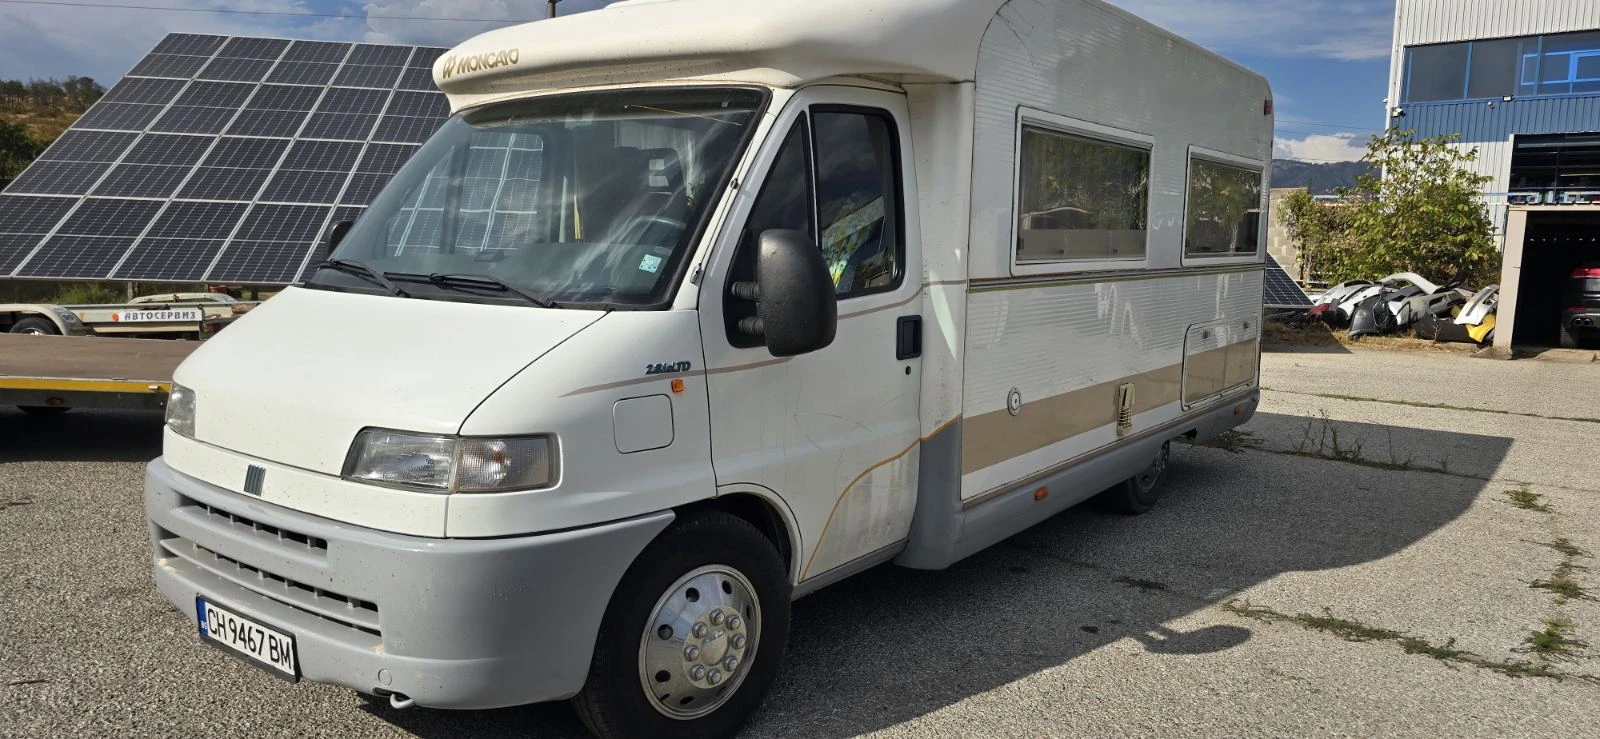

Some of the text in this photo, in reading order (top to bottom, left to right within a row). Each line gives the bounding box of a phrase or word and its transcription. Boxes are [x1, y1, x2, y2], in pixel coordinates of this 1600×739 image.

[457, 48, 519, 74] MONCAYO
[124, 311, 196, 321] АВТОСЕРВИЗ
[228, 617, 265, 656] 9467
